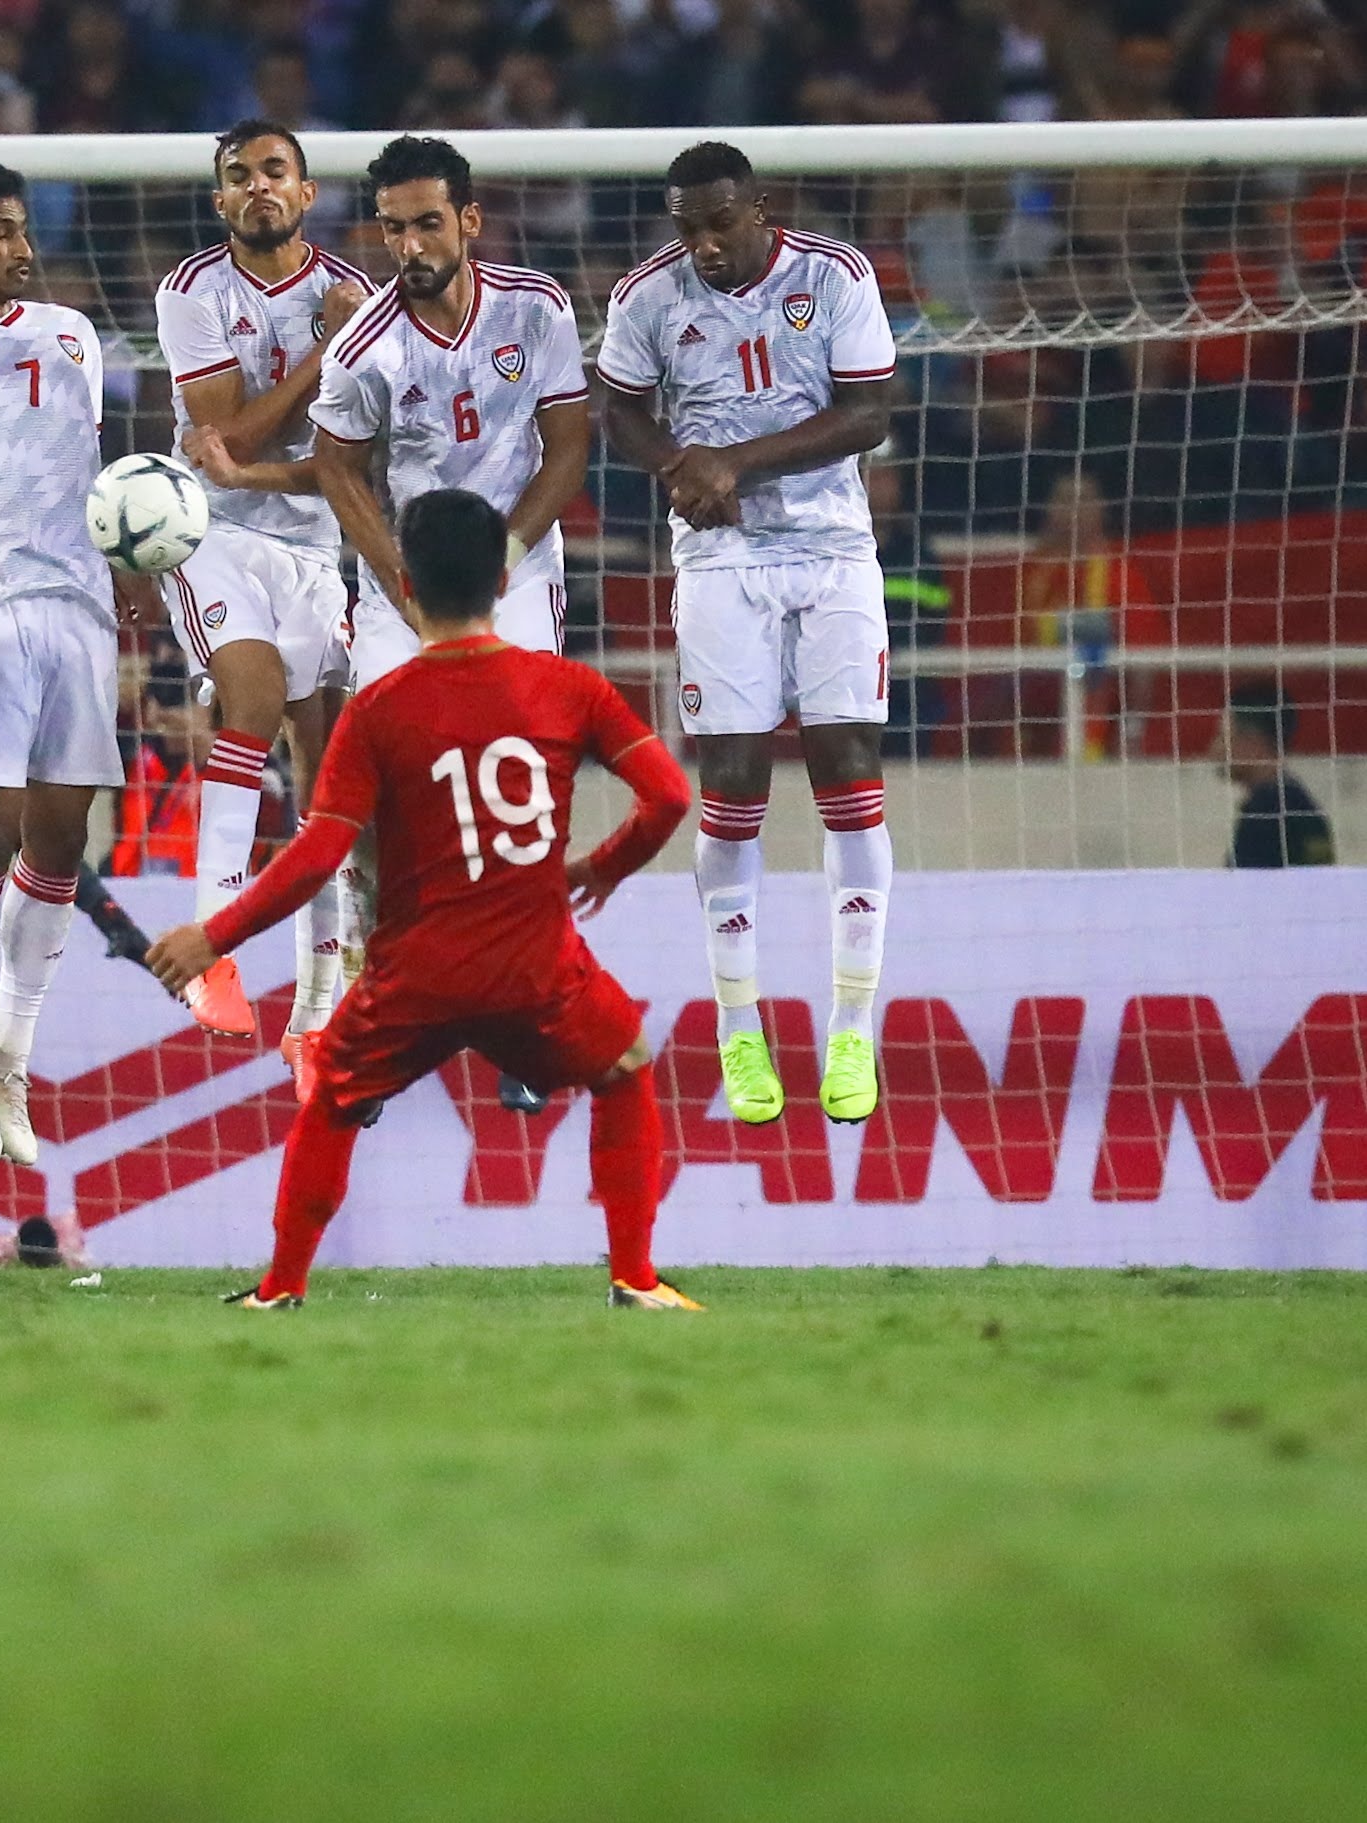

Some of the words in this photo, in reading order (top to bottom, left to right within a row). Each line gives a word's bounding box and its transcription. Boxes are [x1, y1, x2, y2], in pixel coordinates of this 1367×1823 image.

[14, 358, 41, 407] 7
[269, 347, 288, 384] 3
[737, 335, 773, 393] 11
[452, 389, 480, 444] 6
[430, 735, 558, 883] 19
